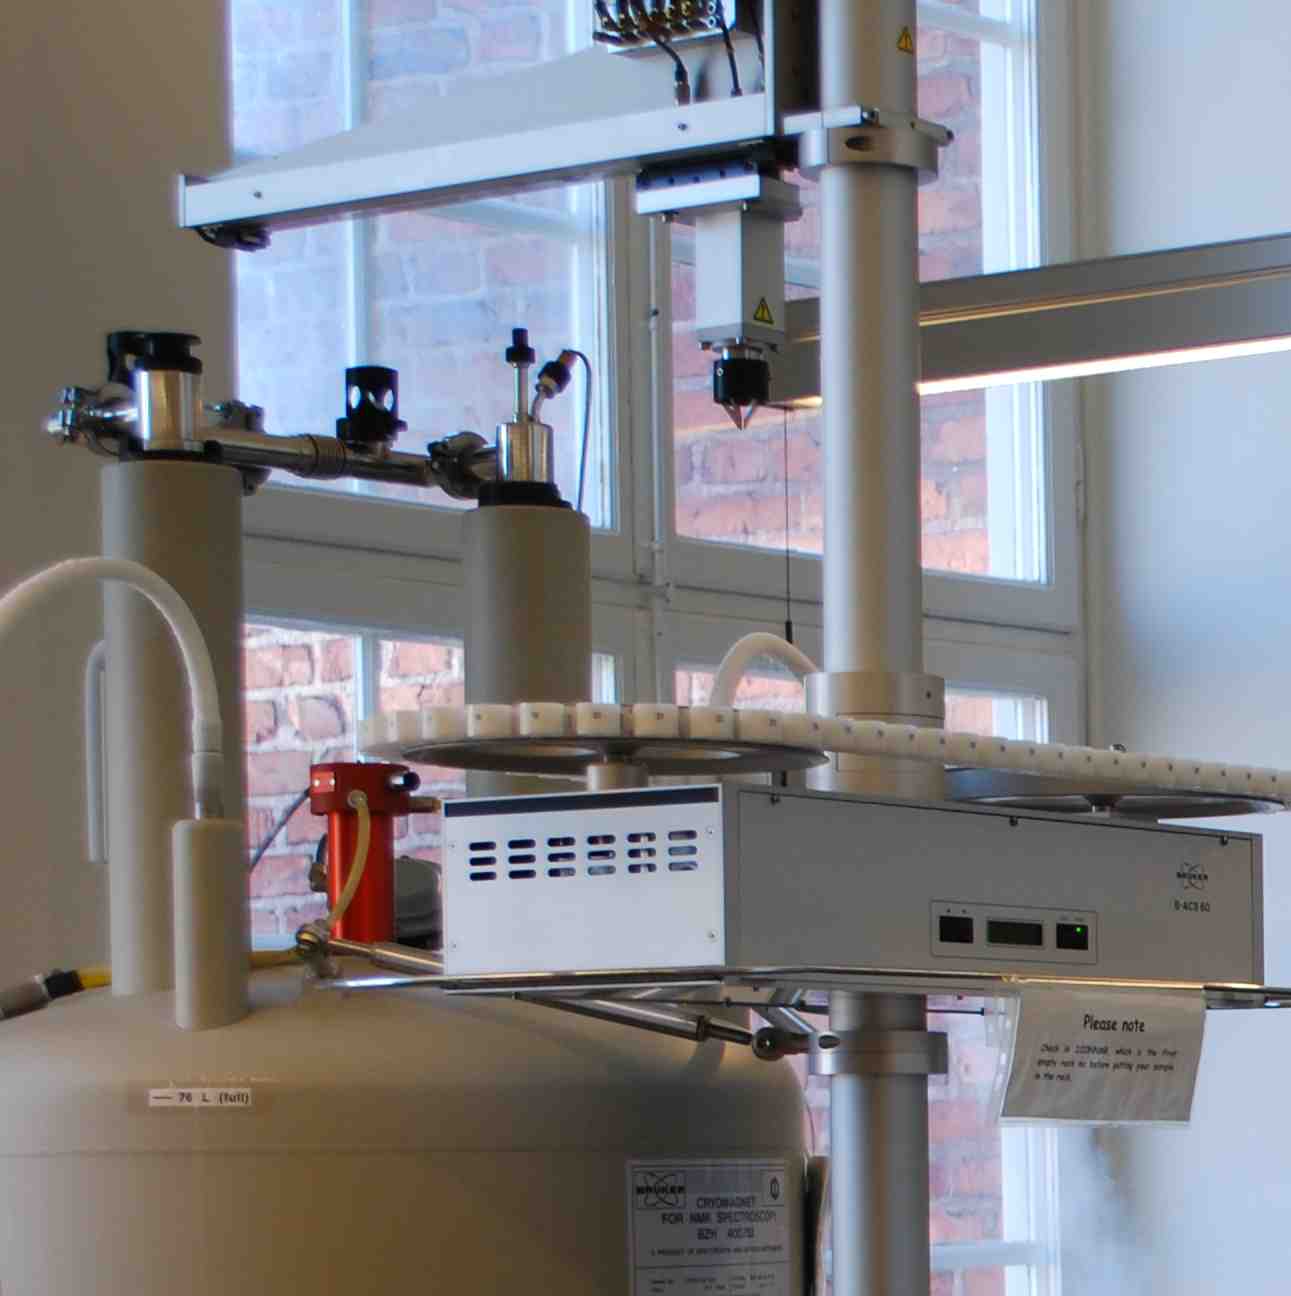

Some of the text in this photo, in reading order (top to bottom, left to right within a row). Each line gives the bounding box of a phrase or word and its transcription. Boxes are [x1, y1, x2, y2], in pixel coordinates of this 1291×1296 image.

[1083, 1013, 1145, 1033] Please note
[219, 1092, 249, 1104] (full)
[662, 1213, 684, 1225] FOR
